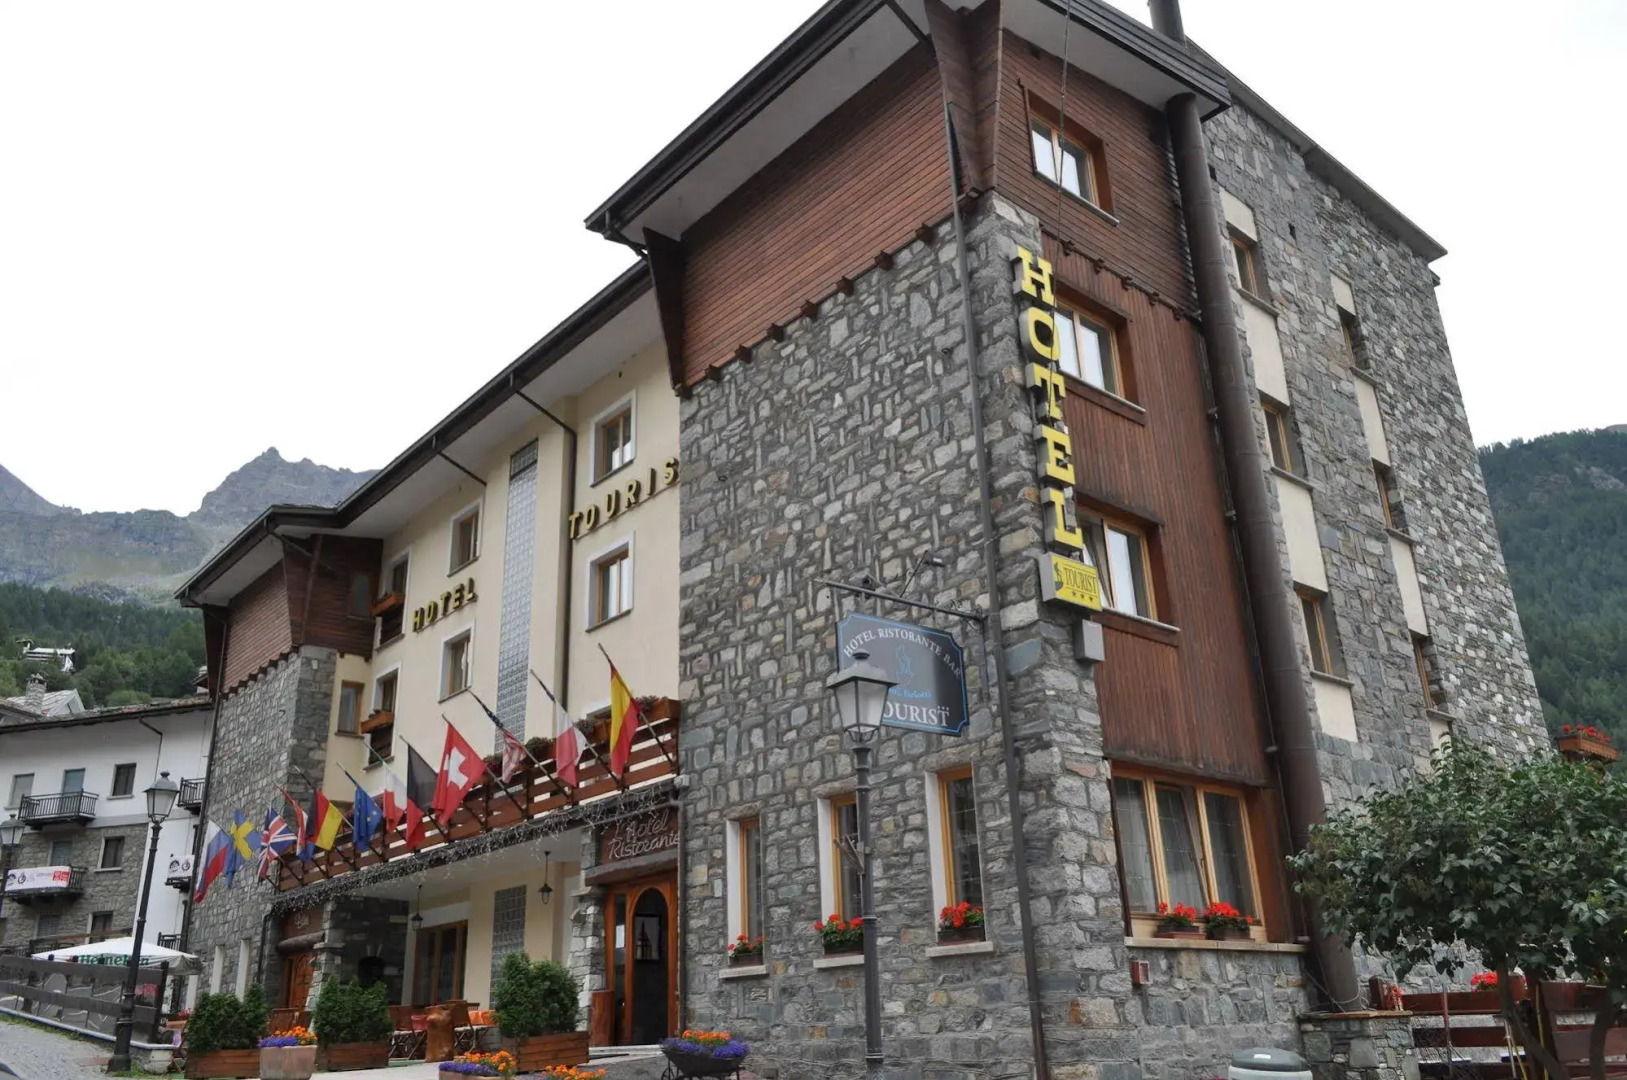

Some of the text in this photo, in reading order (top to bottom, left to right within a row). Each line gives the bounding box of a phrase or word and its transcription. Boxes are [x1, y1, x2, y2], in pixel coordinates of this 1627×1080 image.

[1014, 246, 1083, 549] HOTEL
[412, 456, 679, 631] HOTEL TOURIS
[1063, 567, 1096, 594] TOURIST
[843, 628, 961, 679] HOTEL RISTORANTE BAR
[883, 701, 950, 726] OURIST
